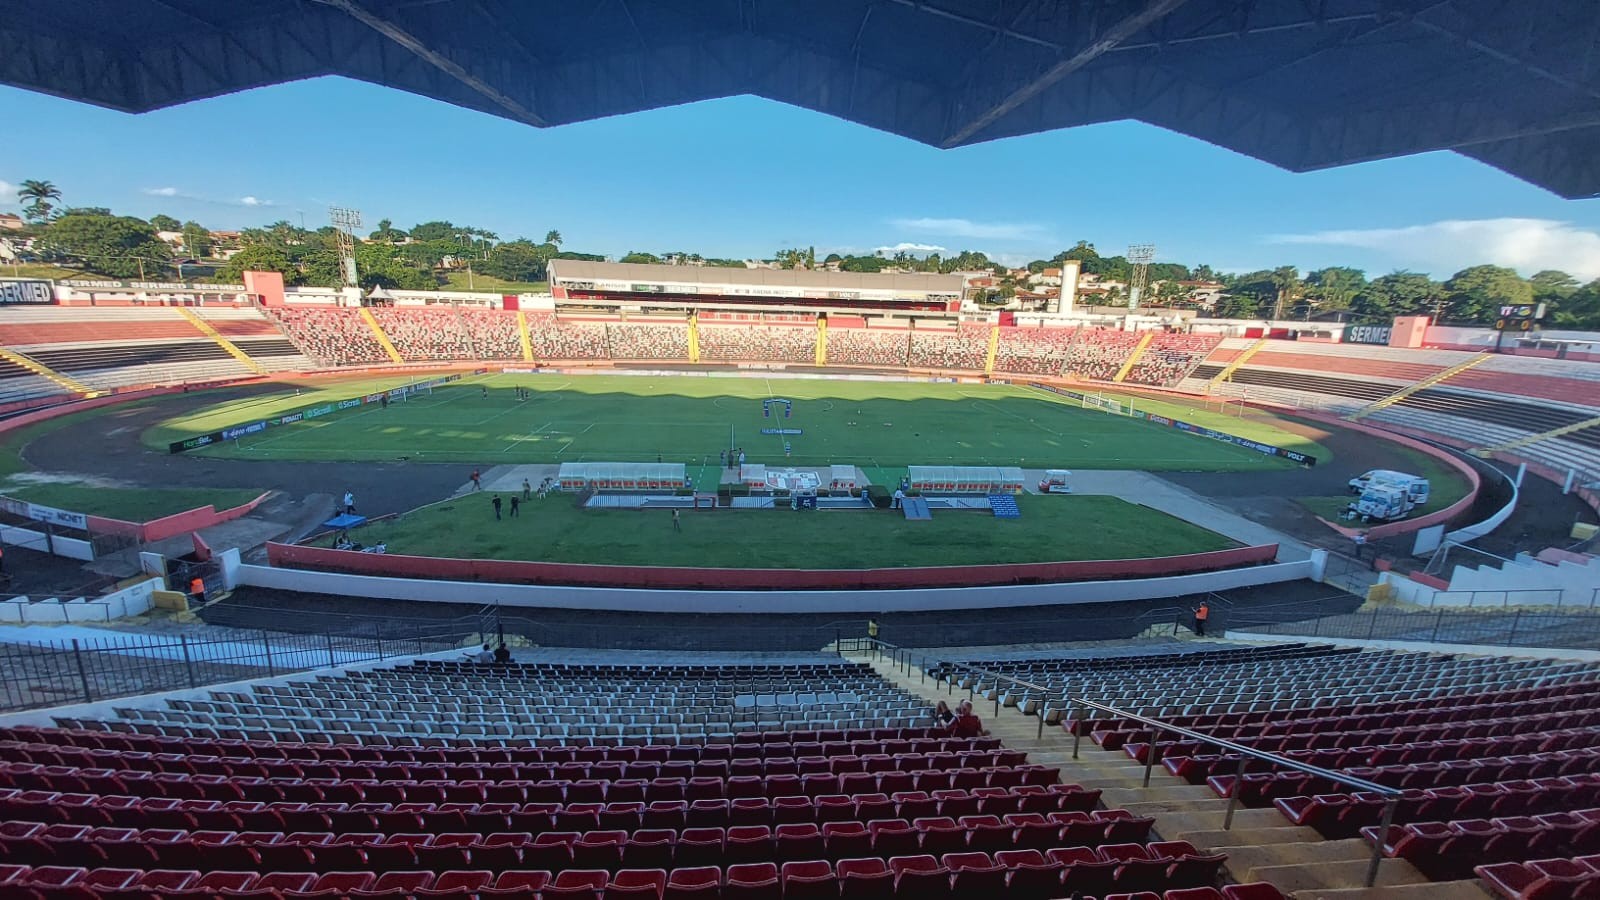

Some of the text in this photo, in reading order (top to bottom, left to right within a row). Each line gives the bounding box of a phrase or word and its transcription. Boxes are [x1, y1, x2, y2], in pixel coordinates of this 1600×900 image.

[60, 279, 122, 288] SERMED
[130, 281, 187, 290] SERMED
[192, 283, 246, 291] SERMED
[1287, 451, 1305, 461] VOLT
